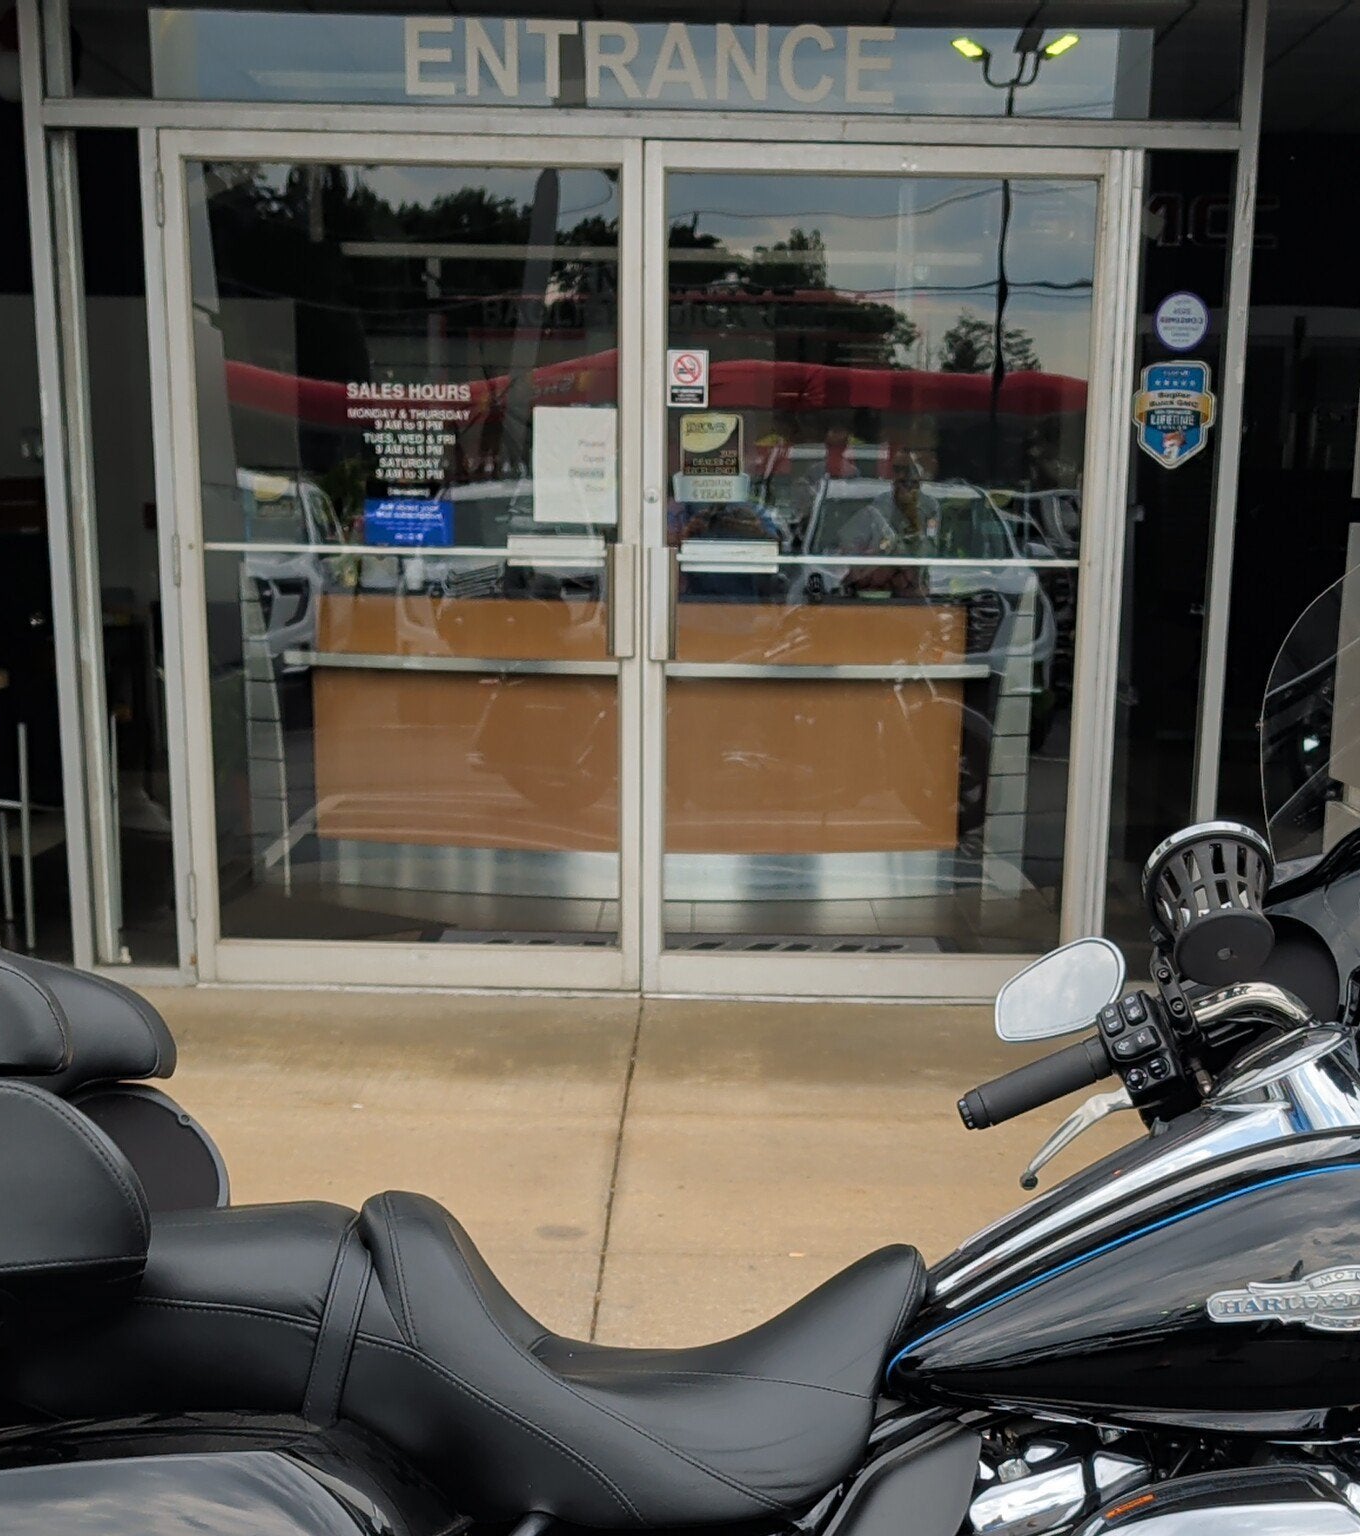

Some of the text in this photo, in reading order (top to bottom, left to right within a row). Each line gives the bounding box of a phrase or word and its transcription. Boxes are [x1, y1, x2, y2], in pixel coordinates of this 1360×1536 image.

[405, 17, 896, 104] ENTRANCE
[346, 382, 471, 400] SALES HOURS
[347, 408, 471, 420] MONDAY & THURSDAY
[1150, 414, 1195, 425] LIFETIME
[384, 420, 401, 430] AM
[403, 421, 416, 430] to
[426, 420, 444, 430] PM
[398, 433, 425, 444] WED
[426, 434, 435, 444] &
[436, 434, 456, 445] FRI
[384, 445, 402, 454] AM
[403, 445, 416, 454] to
[426, 445, 444, 455] PM
[379, 458, 440, 468] SATURDAY
[385, 469, 402, 479] AM
[403, 469, 416, 478] to
[426, 469, 444, 479] PM
